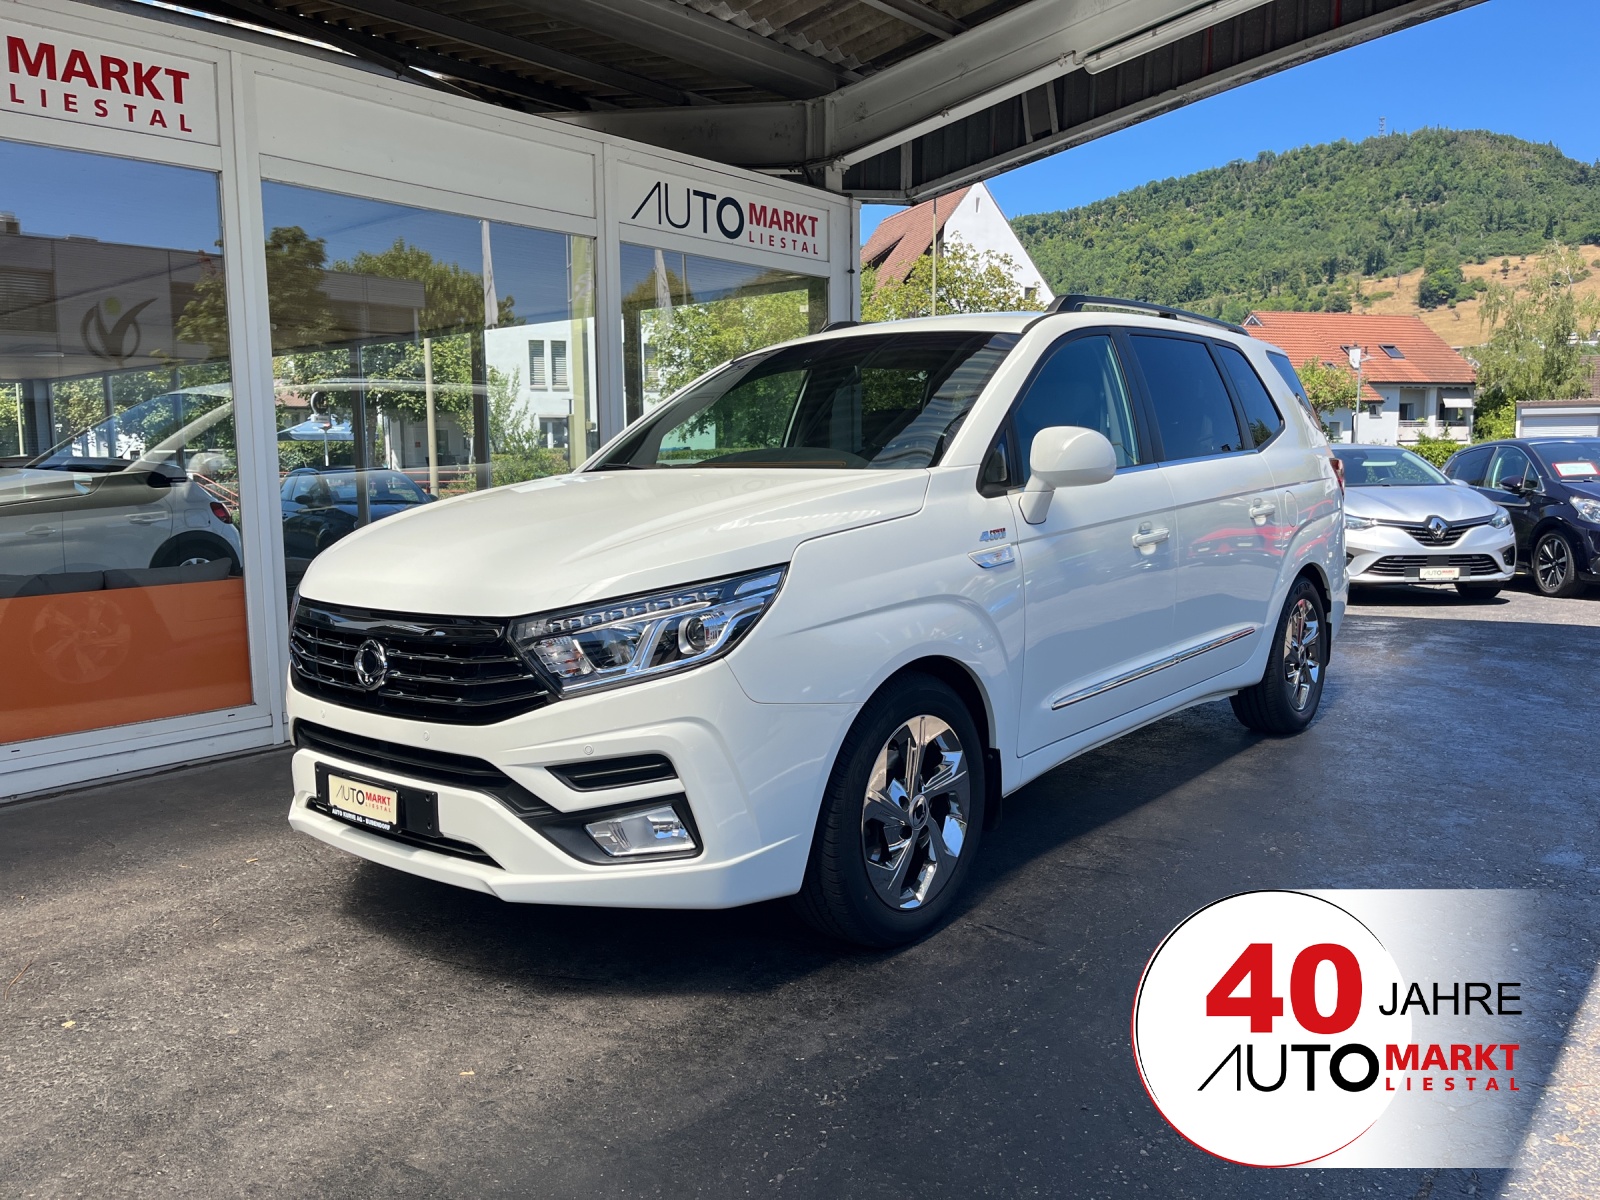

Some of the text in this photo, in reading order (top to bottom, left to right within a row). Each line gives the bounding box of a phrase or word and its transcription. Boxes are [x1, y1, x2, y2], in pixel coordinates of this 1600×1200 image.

[6, 35, 190, 105] MARKT
[9, 83, 193, 133] LIESTAL
[631, 181, 819, 240] AUTO MARKT
[749, 231, 819, 255] LIESTAL
[335, 785, 391, 807] AUTO MARKT
[365, 803, 392, 813] LIESTAL
